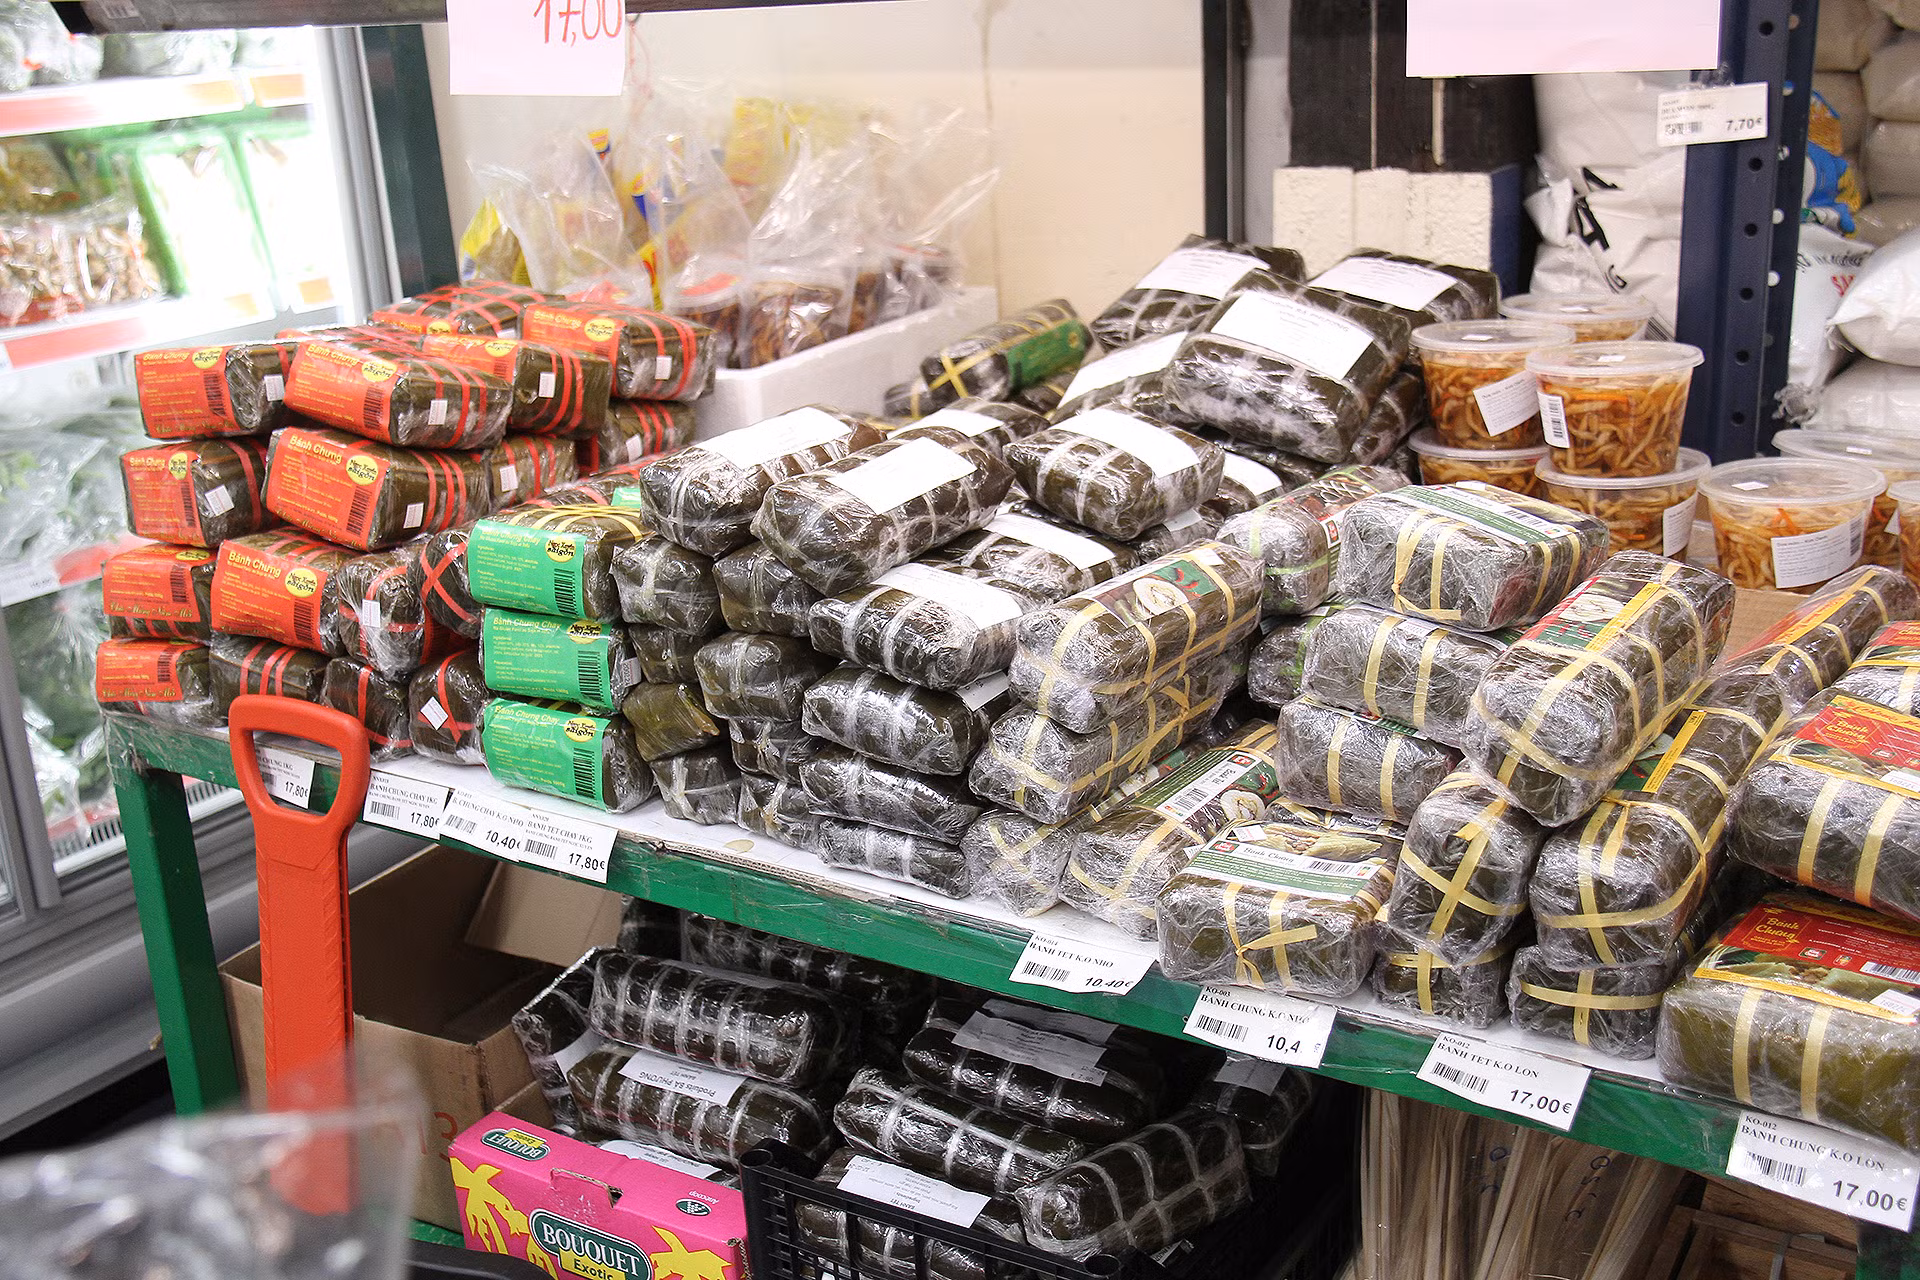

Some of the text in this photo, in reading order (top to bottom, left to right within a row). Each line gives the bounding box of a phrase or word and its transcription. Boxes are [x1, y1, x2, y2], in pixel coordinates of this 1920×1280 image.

[534, 0, 623, 48] 17,00
[568, 852, 606, 871] 17,80€
[1029, 941, 1056, 956] BANH
[1057, 949, 1076, 961] TET
[1200, 993, 1230, 1009] BANH
[1230, 1000, 1267, 1017] CHUNG
[1443, 1035, 1471, 1050] KO-012
[1437, 1042, 1468, 1060] BANH
[1470, 1053, 1492, 1066] TET
[1514, 1065, 1540, 1079] LON
[1510, 1088, 1572, 1115] 17,00€
[1745, 1114, 1778, 1131] KO-012
[486, 1132, 544, 1159] BOUQUET
[1741, 1124, 1777, 1145] BANH
[1779, 1136, 1826, 1155] CHUNG
[542, 1221, 641, 1278] BOUQUET
[573, 1257, 614, 1280] Exotic
